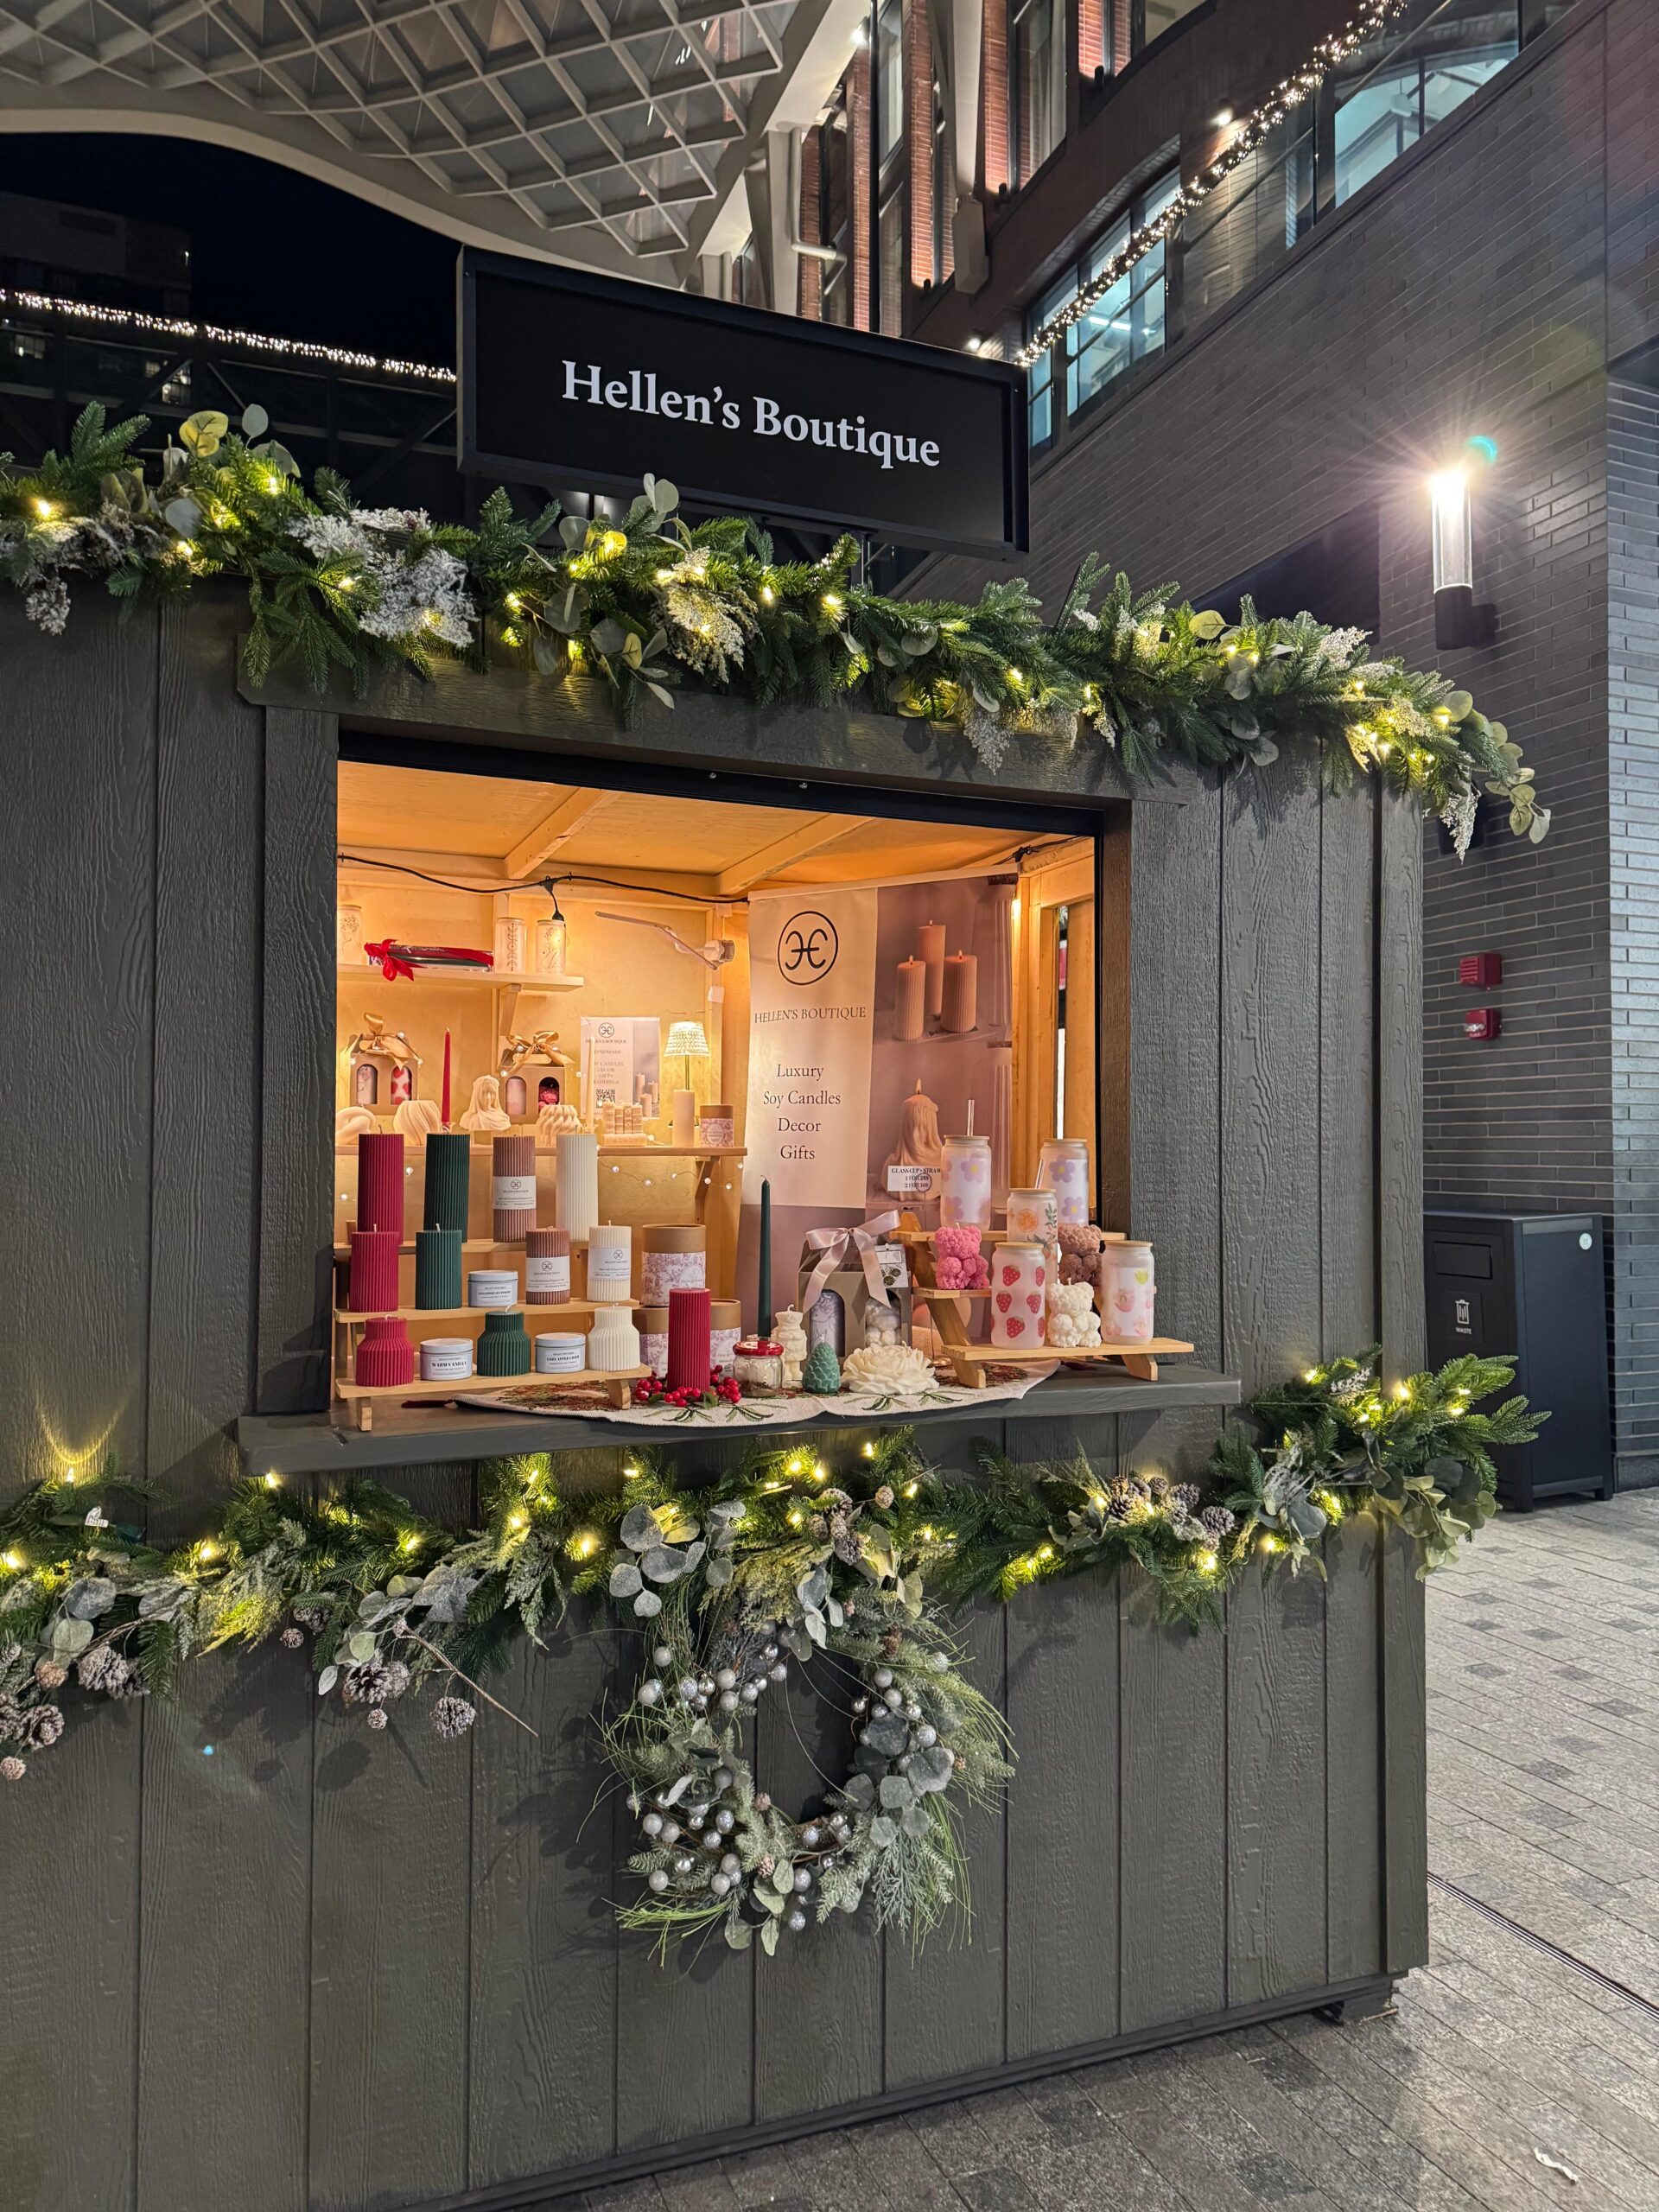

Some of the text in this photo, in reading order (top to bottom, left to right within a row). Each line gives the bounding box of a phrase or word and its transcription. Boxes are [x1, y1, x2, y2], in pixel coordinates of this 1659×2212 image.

[563, 360, 939, 468] Hellen's Boutique
[754, 1007, 866, 1023] HELLEN'S BOUTIQUE
[777, 1064, 824, 1082] Luxury
[763, 1090, 841, 1109] Soy Candles
[778, 1117, 822, 1132] Decor
[780, 1145, 816, 1160] Gifts
